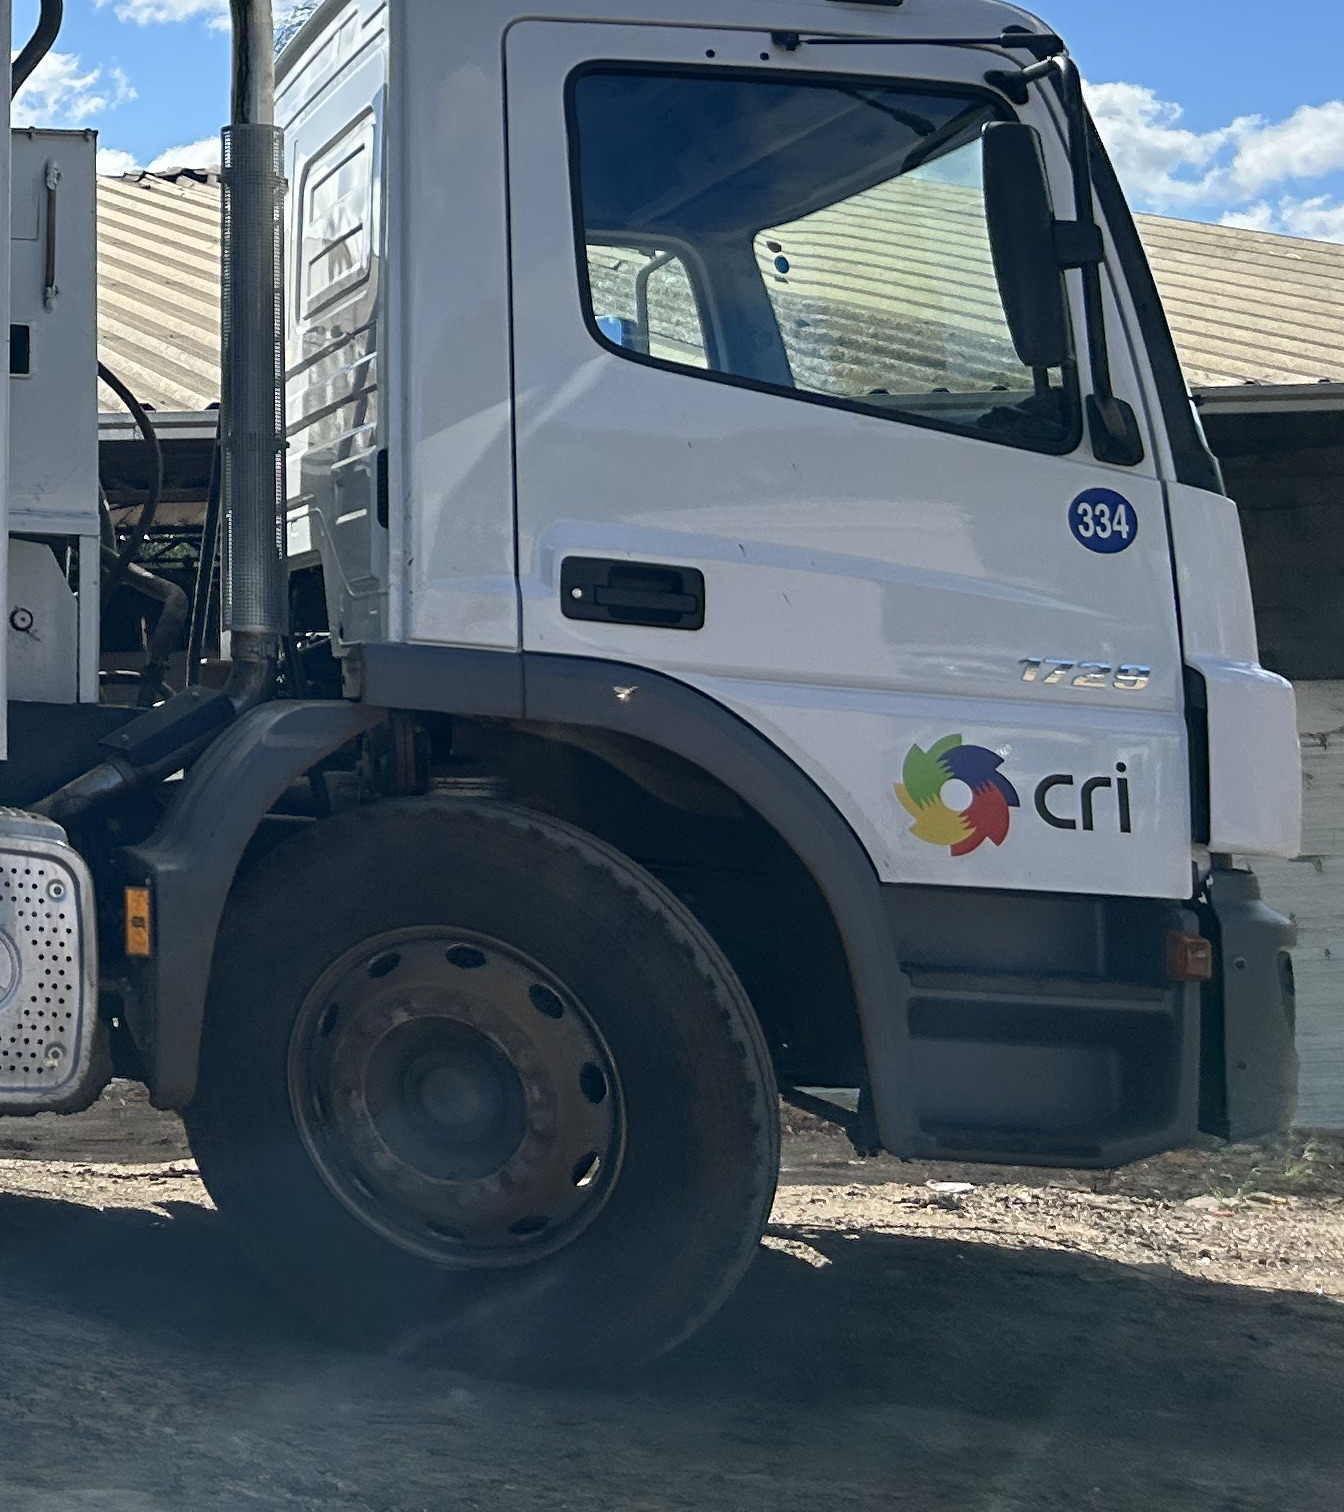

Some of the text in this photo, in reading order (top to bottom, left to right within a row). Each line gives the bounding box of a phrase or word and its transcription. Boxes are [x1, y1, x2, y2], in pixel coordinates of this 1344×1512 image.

[1076, 503, 1130, 539] 334
[1019, 656, 1151, 690] 1729
[1033, 761, 1132, 834] cri
